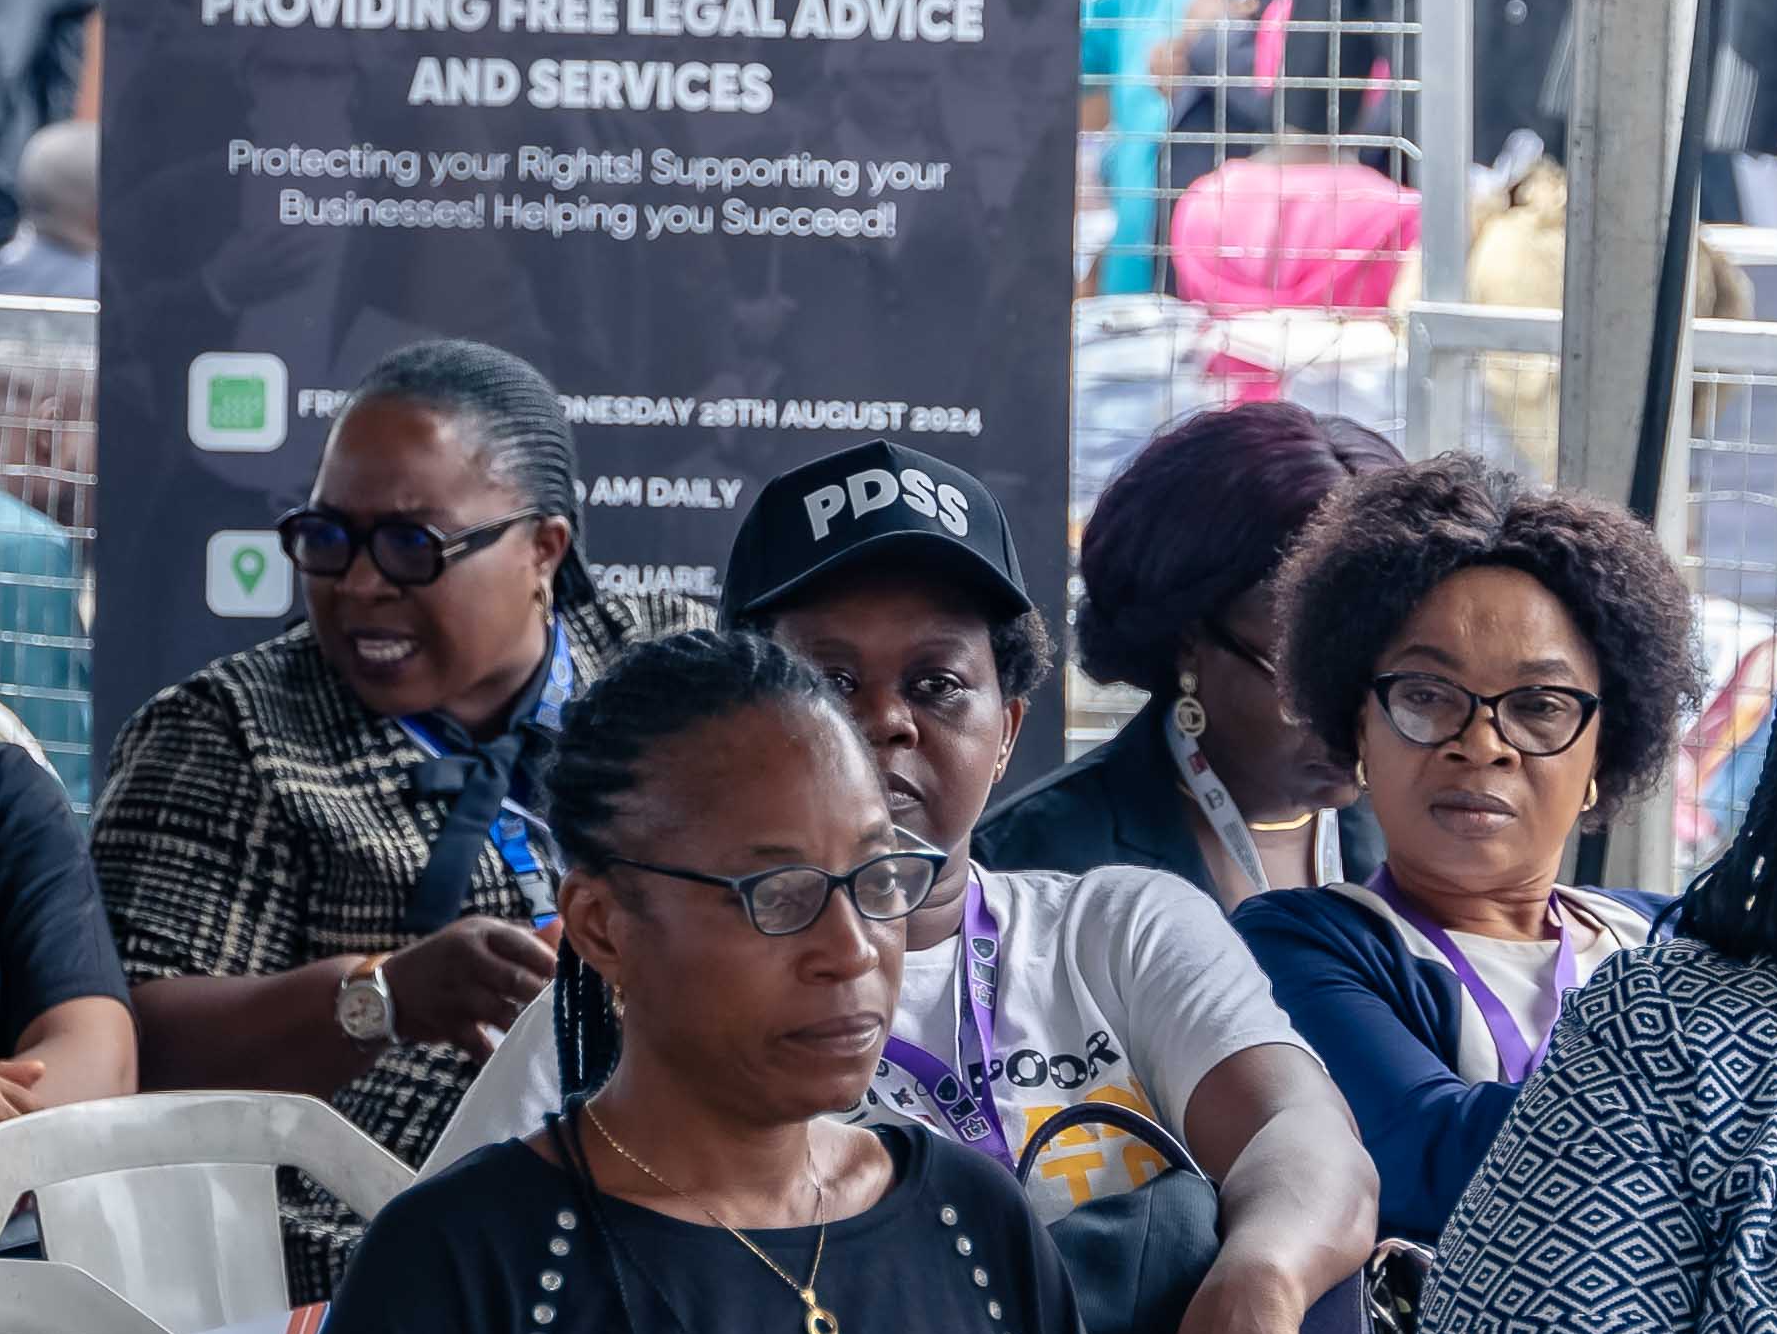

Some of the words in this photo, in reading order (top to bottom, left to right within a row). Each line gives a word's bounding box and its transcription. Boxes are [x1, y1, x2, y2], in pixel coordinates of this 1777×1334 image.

[408, 57, 521, 106] AND
[528, 58, 773, 113] SERVICES
[228, 139, 421, 186] Protecting
[429, 149, 511, 188] your
[517, 142, 642, 188] Rights!
[650, 147, 860, 197] Supporting
[866, 161, 951, 197] your
[279, 188, 485, 229] Businesses!
[493, 192, 640, 238] Helping
[645, 204, 714, 240] you
[722, 198, 897, 239] Succeed!
[558, 395, 695, 427] DNESDAY
[781, 402, 908, 431] AUGUST
[589, 476, 643, 507] AM
[646, 477, 743, 509] DAILY
[804, 467, 969, 541] PDSS
